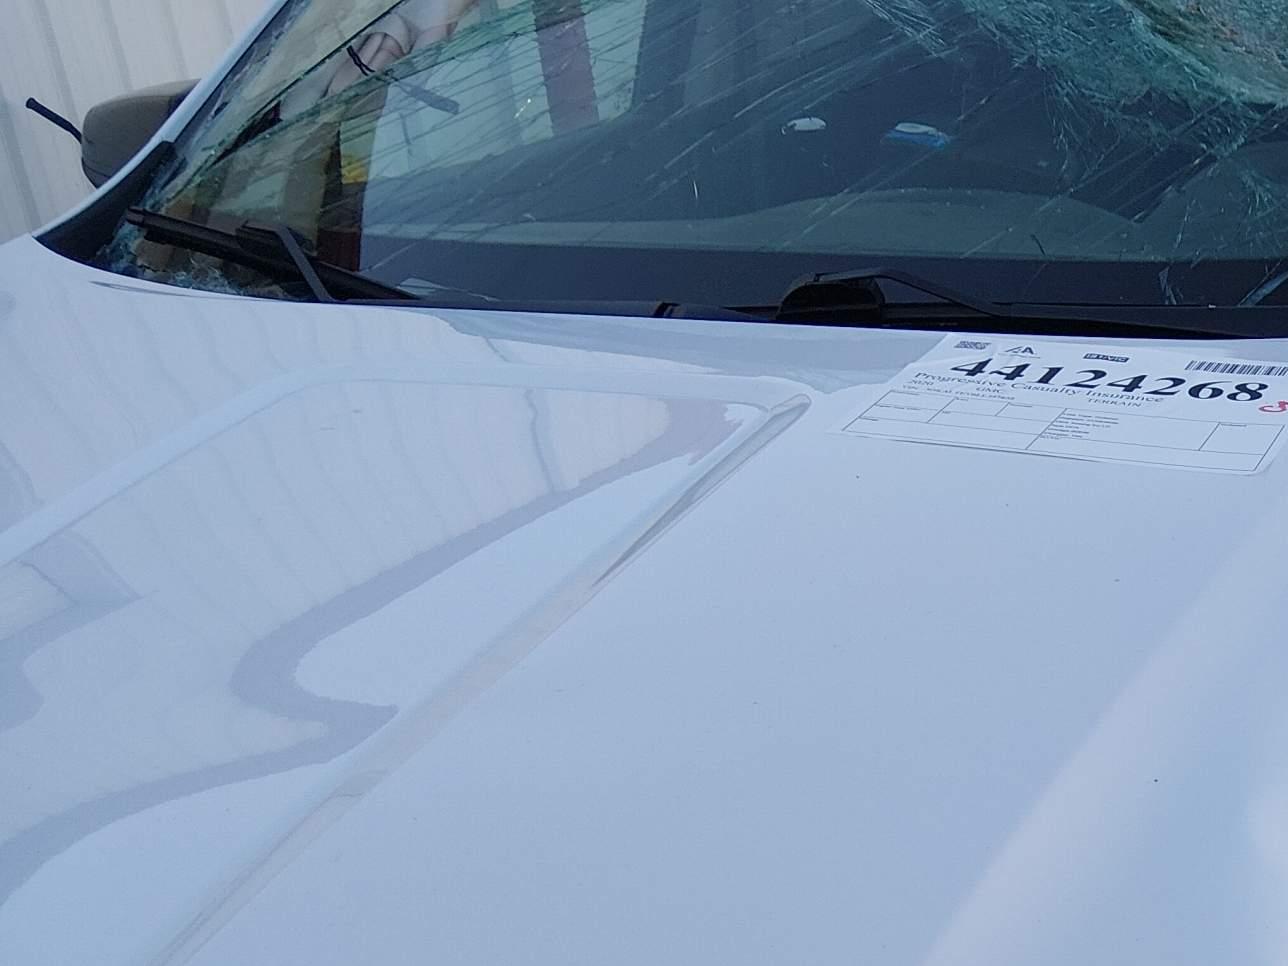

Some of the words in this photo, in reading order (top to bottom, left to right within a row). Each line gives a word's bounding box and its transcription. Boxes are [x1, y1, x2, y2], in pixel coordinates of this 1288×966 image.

[914, 372, 1007, 388] Progressive
[1011, 382, 1081, 396] Casualty
[1086, 390, 1165, 403] Insurance
[950, 357, 1269, 402] 44124268
[1088, 398, 1142, 408] TERRAIN
